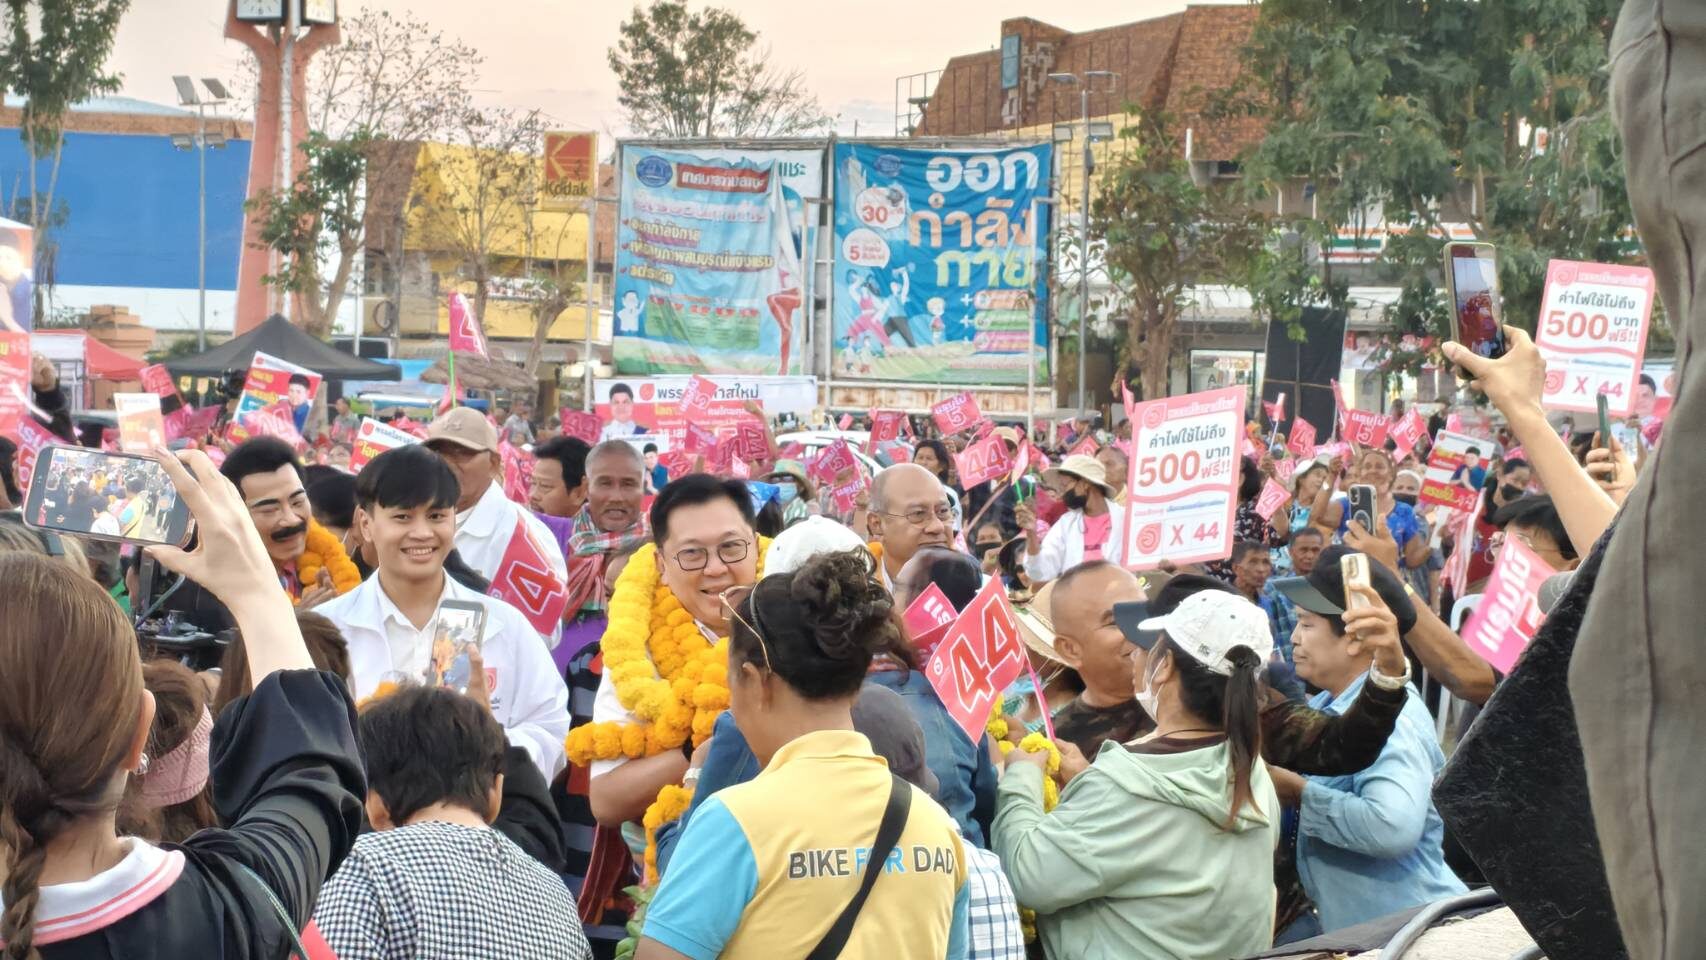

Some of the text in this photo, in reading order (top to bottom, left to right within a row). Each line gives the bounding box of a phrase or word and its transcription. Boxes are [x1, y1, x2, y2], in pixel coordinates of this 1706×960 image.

[926, 152, 1039, 192] ออก
[545, 181, 588, 196] Kodak
[862, 204, 889, 223] 30
[908, 192, 1034, 247] กำลัง
[850, 245, 860, 262] 5
[935, 249, 1033, 287] กาย
[1558, 290, 1636, 310] ค่าไฟใช้ไม่ถึง
[1546, 310, 1638, 341] 500 บาท
[1598, 381, 1623, 398] 44
[947, 408, 967, 426] 5
[1149, 423, 1226, 449] ค่าไฟใช้ไม่ถึง
[1357, 422, 1375, 446] 5
[966, 440, 1008, 479] 44
[1138, 445, 1231, 488] 500 บาท
[1193, 521, 1220, 542] 44
[950, 593, 1023, 714] 44
[788, 846, 955, 879] BIKE FR DAD
